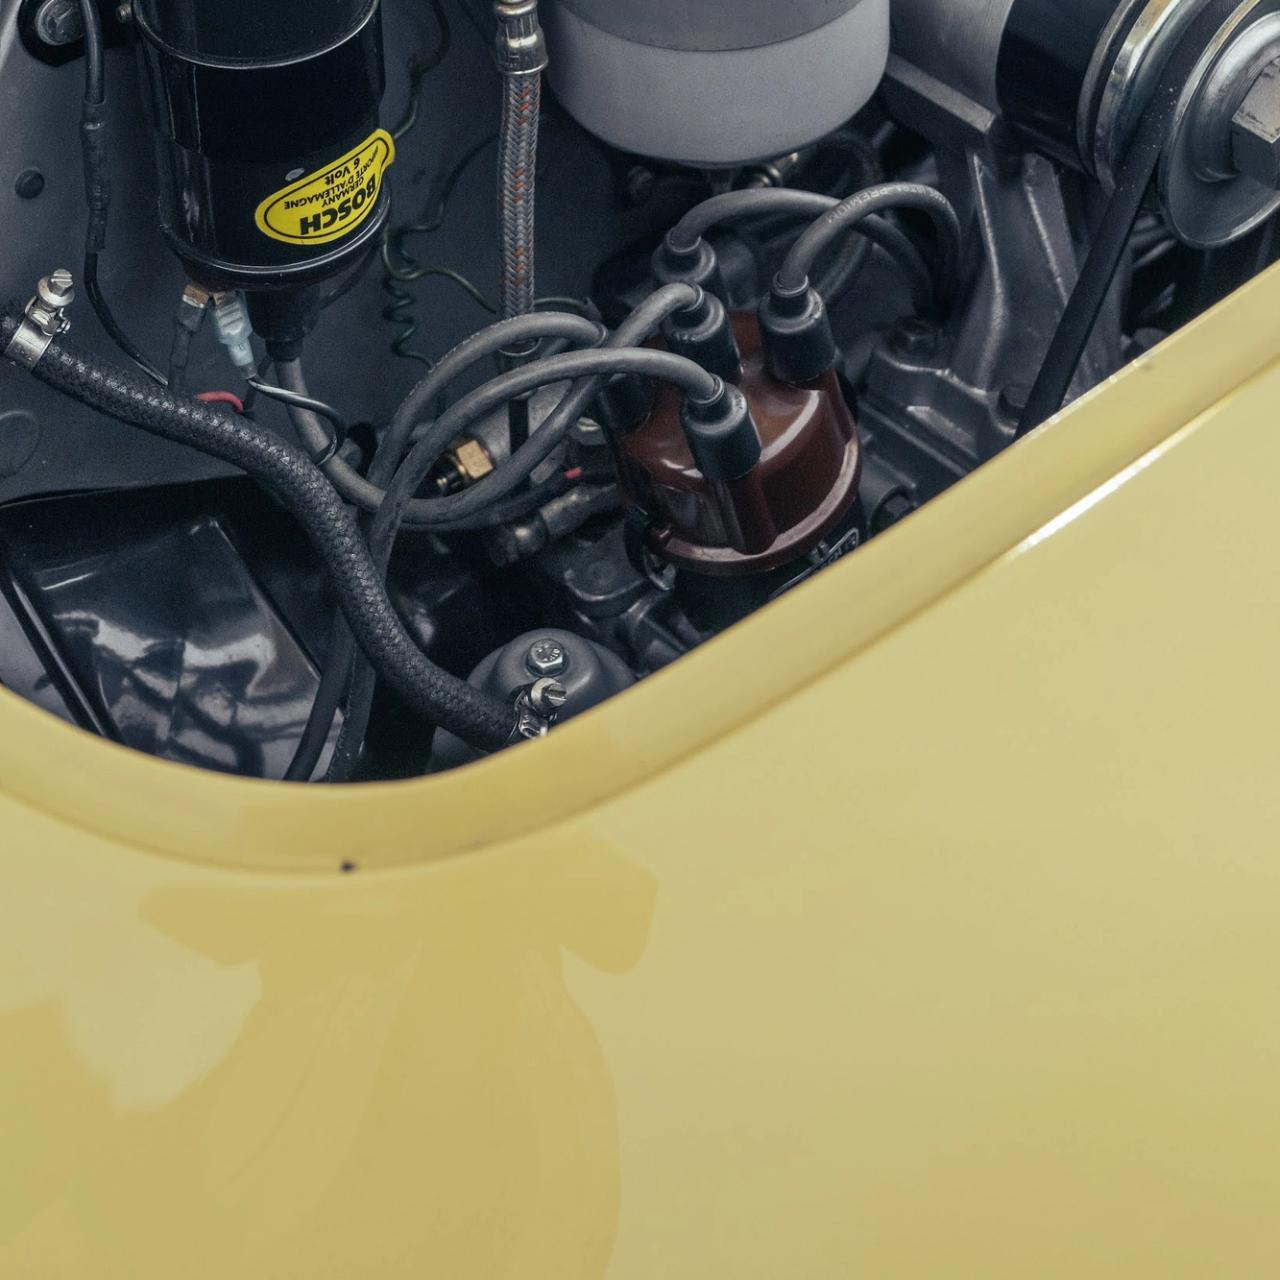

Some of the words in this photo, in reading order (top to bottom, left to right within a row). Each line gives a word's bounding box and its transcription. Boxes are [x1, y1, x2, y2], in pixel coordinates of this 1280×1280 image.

[324, 166, 351, 185] Volt
[353, 157, 360, 169] 6
[284, 178, 355, 210] D'ALLEMAGNE
[300, 174, 376, 236] BOSCH
[322, 177, 364, 206] GERMANY
